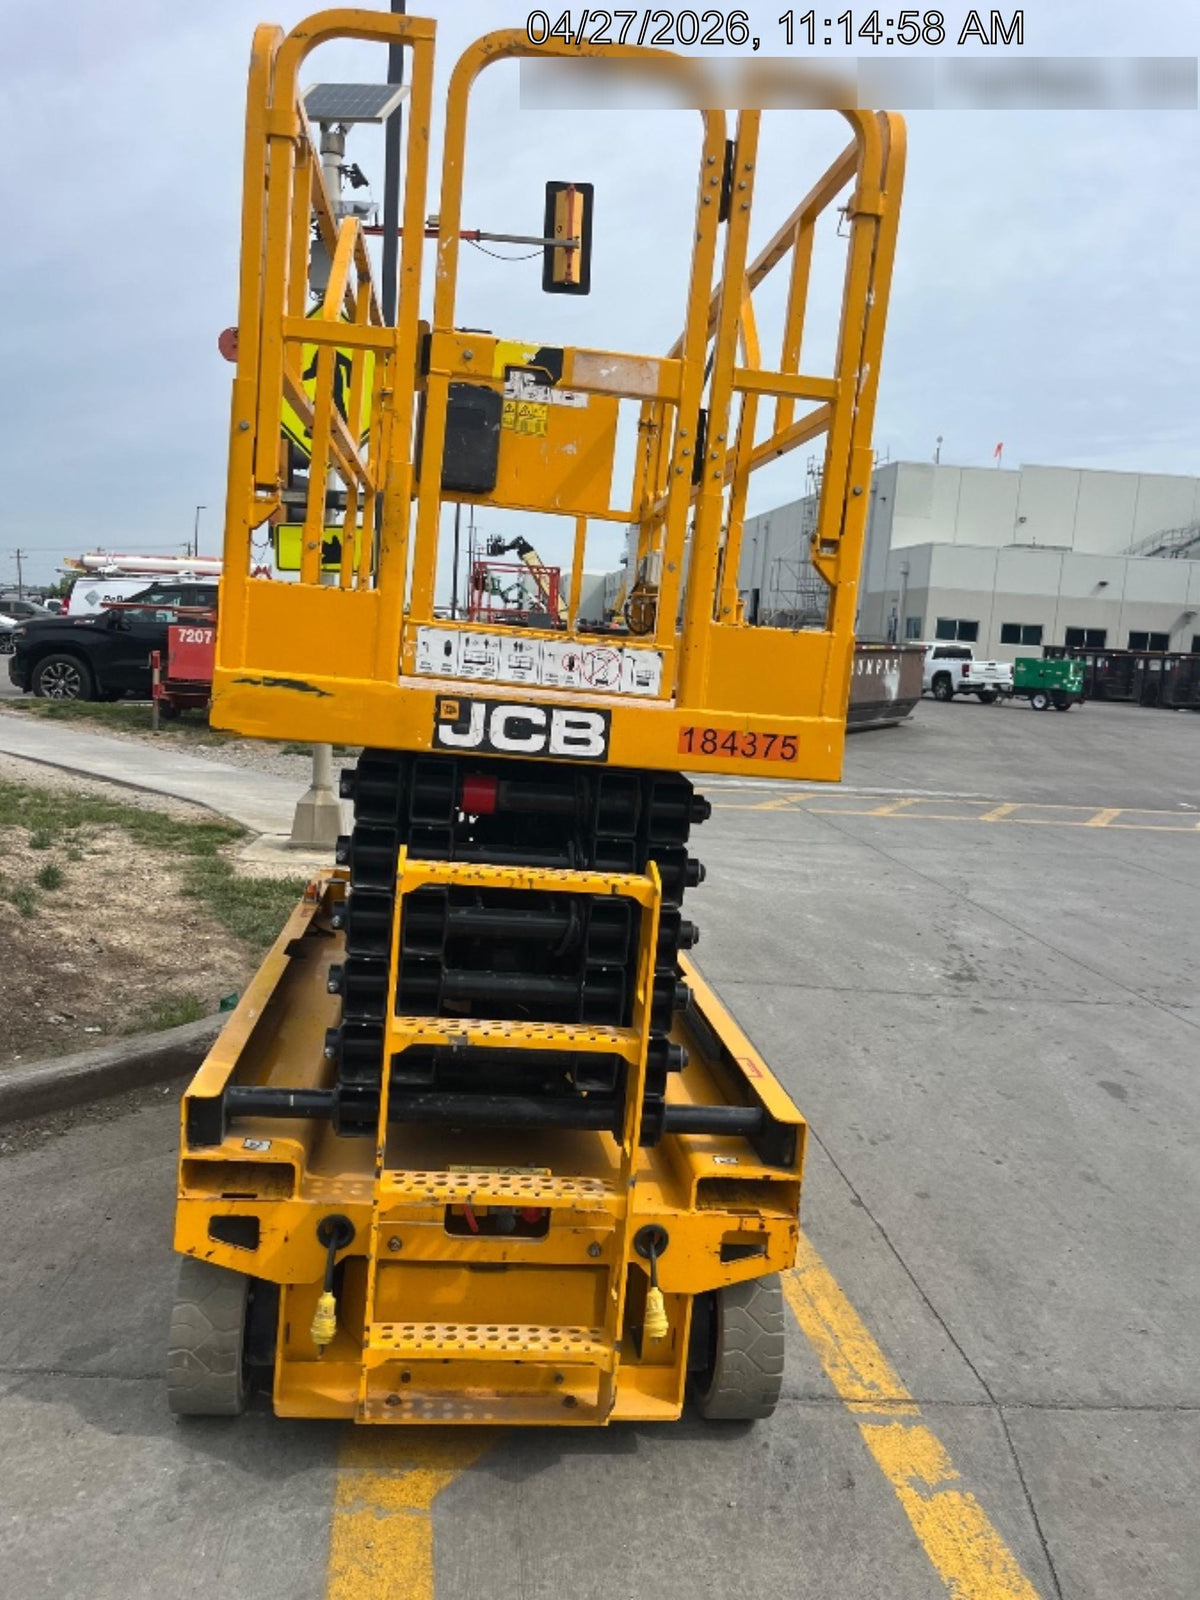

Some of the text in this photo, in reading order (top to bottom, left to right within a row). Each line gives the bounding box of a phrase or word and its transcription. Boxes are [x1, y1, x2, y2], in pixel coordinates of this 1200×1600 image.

[178, 629, 212, 644] 7207
[438, 702, 606, 756] JCB
[683, 727, 798, 760] 184375
